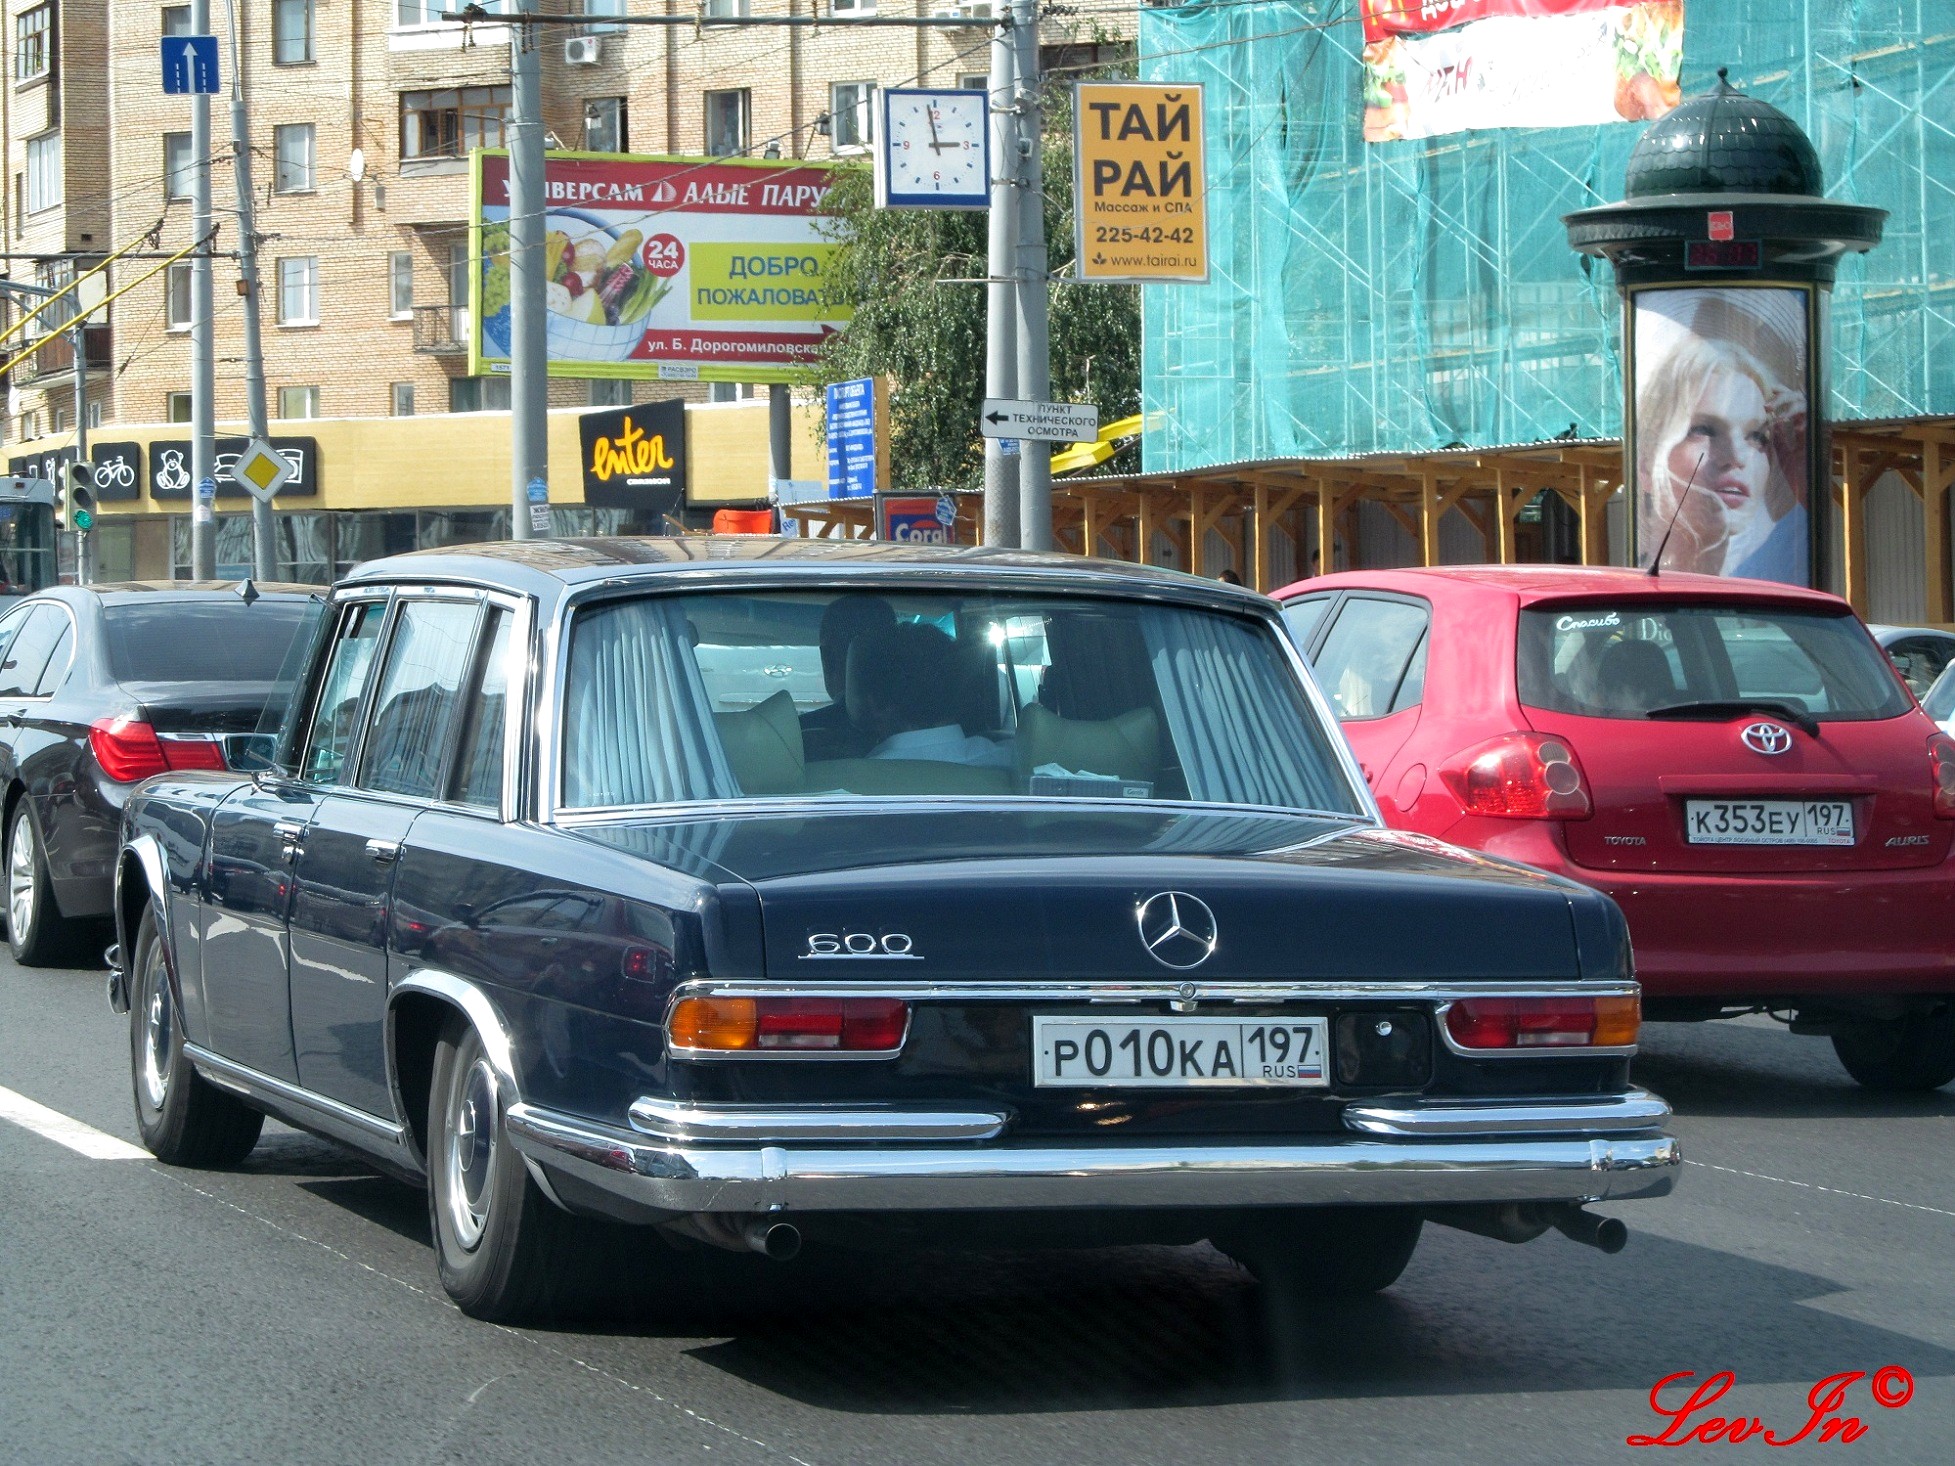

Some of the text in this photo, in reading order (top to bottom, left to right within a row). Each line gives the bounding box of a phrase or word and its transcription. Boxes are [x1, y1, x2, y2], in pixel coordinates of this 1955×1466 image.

[1089, 94, 1190, 141] ТАЙ
[903, 141, 910, 150] 9
[963, 141, 970, 150] 3
[933, 171, 941, 180] 6
[1094, 151, 1192, 197] РАЙ
[683, 181, 751, 206] АЛЫЕ
[761, 184, 835, 208] ПАРУ
[1094, 202, 1148, 213] Массаж
[1165, 202, 1193, 213] СПА
[1096, 227, 1194, 243] 225-42-42
[648, 240, 679, 259] 24
[648, 260, 679, 269] ЧАСА
[729, 256, 819, 279] ДОБРО
[1110, 254, 1197, 267] www.tairai.ru
[648, 341, 668, 352] ул.
[672, 338, 687, 350] Б.
[1040, 404, 1072, 415] ПУНКТ
[1013, 413, 1096, 427] ТЕХНИЧЕСКОГО
[1027, 426, 1079, 437] ОСМОТРА
[590, 416, 674, 481] enter
[1556, 612, 1620, 631] Спасибо
[1641, 617, 1673, 641] Dio
[1807, 804, 1844, 826] 197
[1817, 827, 1836, 835] RUS
[1605, 836, 1646, 845] TOYOTA
[1885, 835, 1930, 847] AURIS
[809, 933, 912, 953] 600
[1248, 1026, 1313, 1063] 197
[1263, 1065, 1296, 1078] RUS
